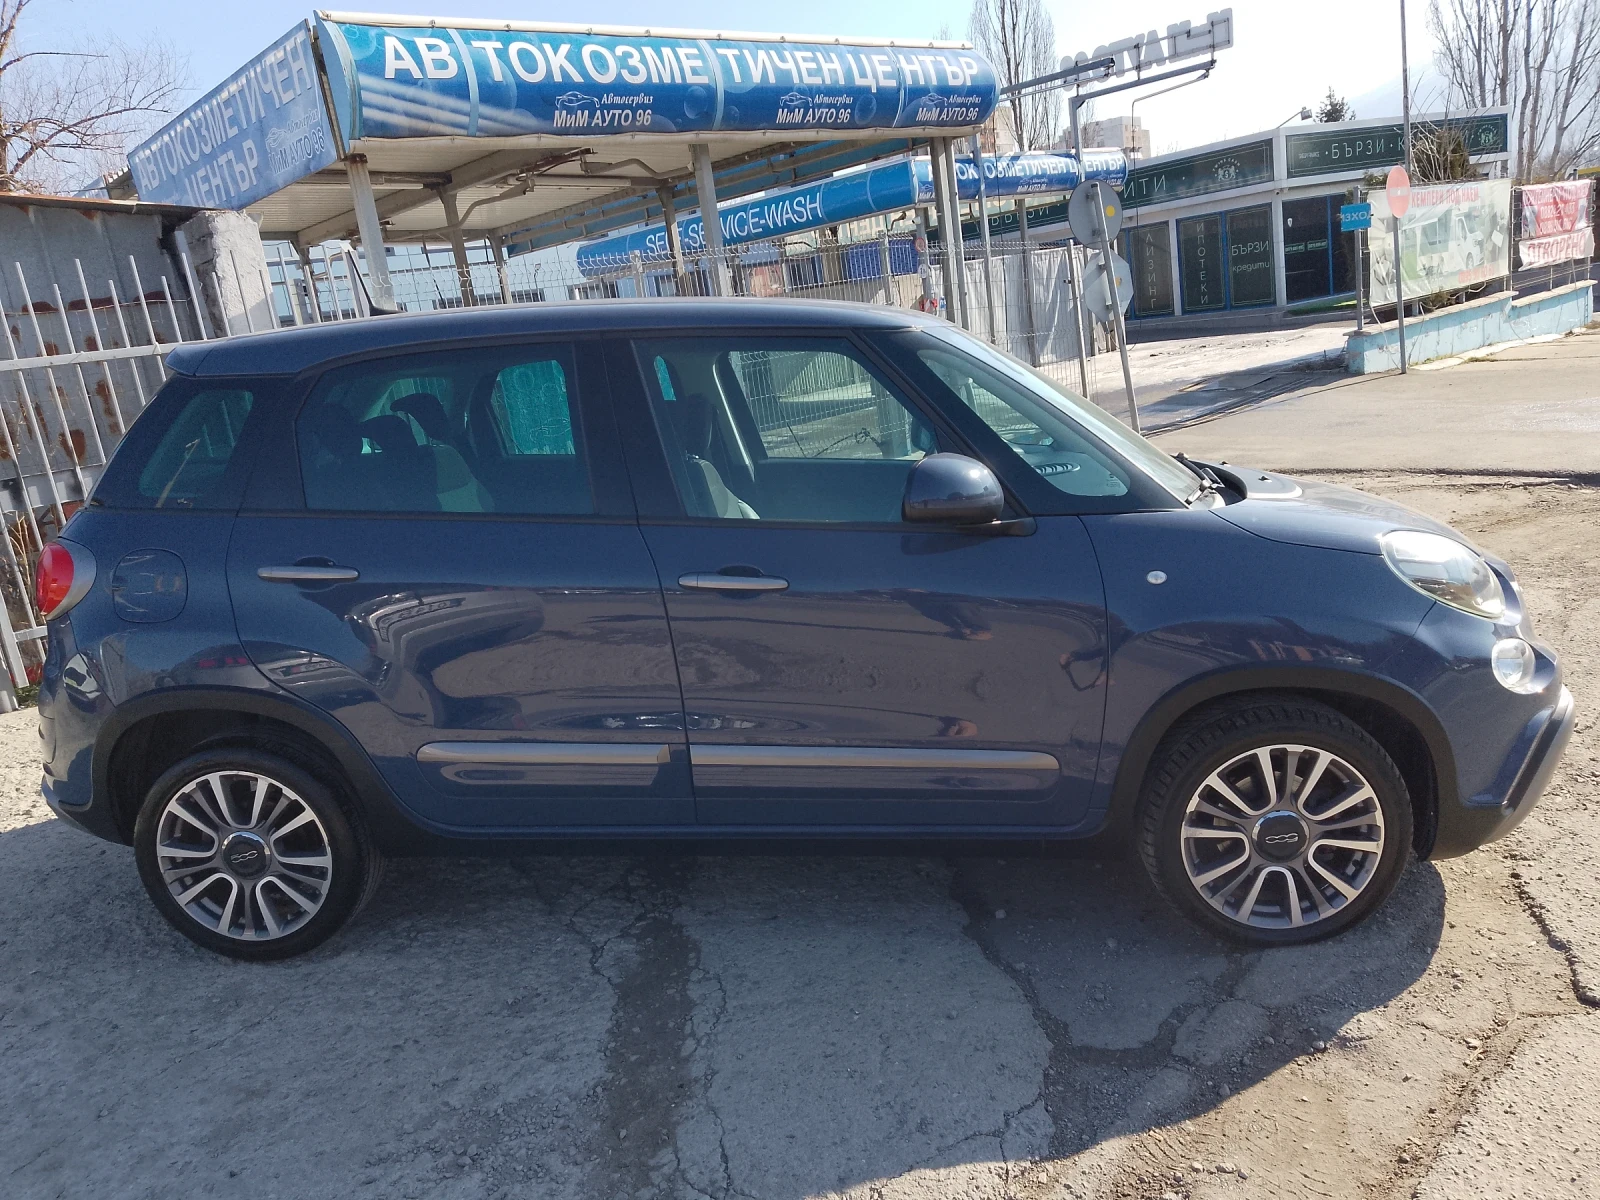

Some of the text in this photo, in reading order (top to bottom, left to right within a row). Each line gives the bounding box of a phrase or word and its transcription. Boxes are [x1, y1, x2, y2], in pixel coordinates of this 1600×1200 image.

[846, 51, 979, 93] ЦЕНТЪР
[601, 92, 654, 107] Автосервиз
[813, 93, 854, 107] Автосервиз
[134, 29, 312, 207] АВТОКОЗМЕТИЧЕН ЦЕНТЪР
[553, 108, 652, 127] МиМ АУТО 96
[775, 108, 851, 124] МиМ АУТО 96
[939, 107, 967, 121] АУТО
[966, 107, 979, 121] 96
[288, 133, 313, 165] АУТО
[310, 126, 326, 155] 96
[1330, 137, 1385, 159] БЪРЗИ
[1231, 240, 1270, 256] БЪРЗИ
[1145, 233, 1158, 309] ЛИЗИНГ
[1196, 222, 1209, 305] ИПОТЕКИ
[1232, 261, 1270, 273] кредити
